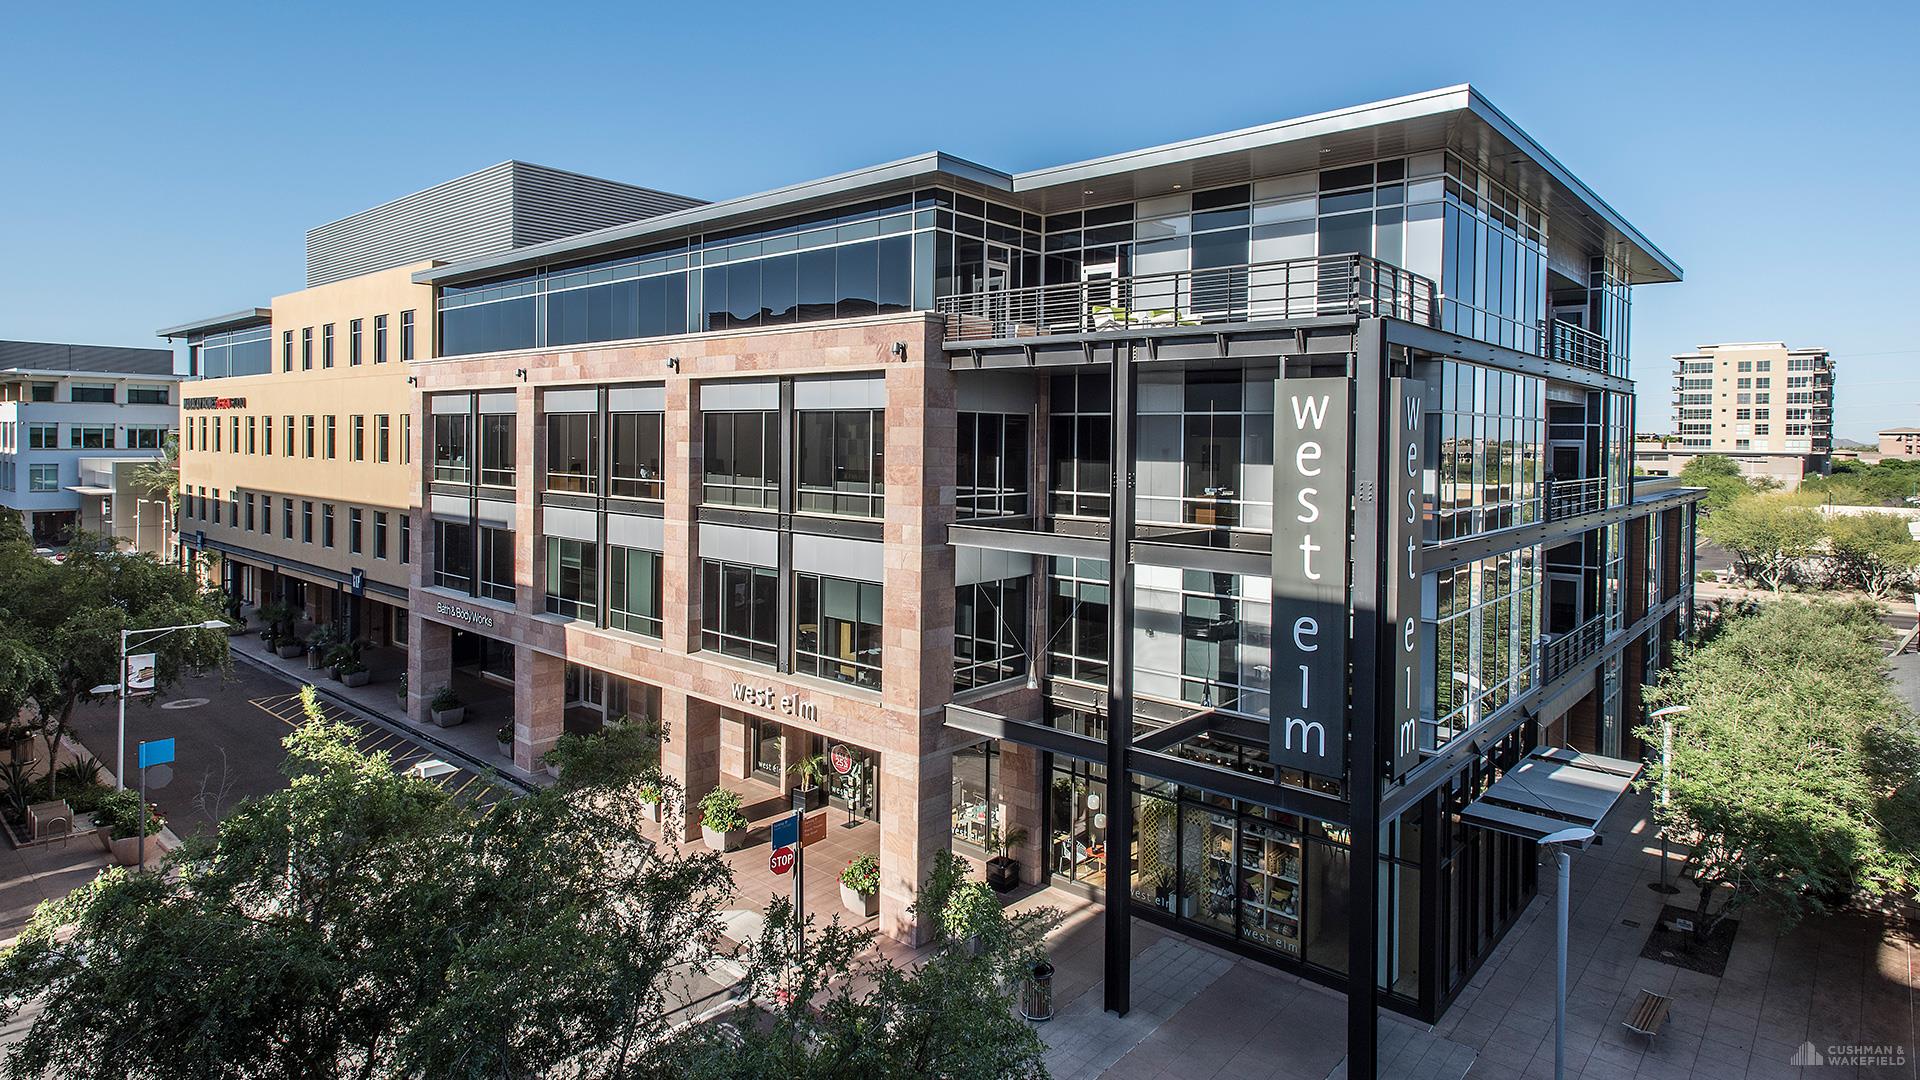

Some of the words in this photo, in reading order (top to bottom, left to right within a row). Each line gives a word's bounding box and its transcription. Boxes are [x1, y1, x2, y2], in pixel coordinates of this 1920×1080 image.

[1291, 395, 1329, 580] west
[1406, 396, 1421, 580] west
[437, 602, 450, 616] Bath
[451, 606, 456, 617] &
[456, 607, 471, 623] Body
[471, 611, 493, 627] Works
[731, 683, 775, 711] west
[781, 693, 818, 722] elm
[1285, 616, 1325, 757] elm
[1400, 617, 1416, 758] elm
[771, 853, 793, 869] STOP
[1242, 926, 1271, 945] west
[1275, 939, 1298, 953] elm
